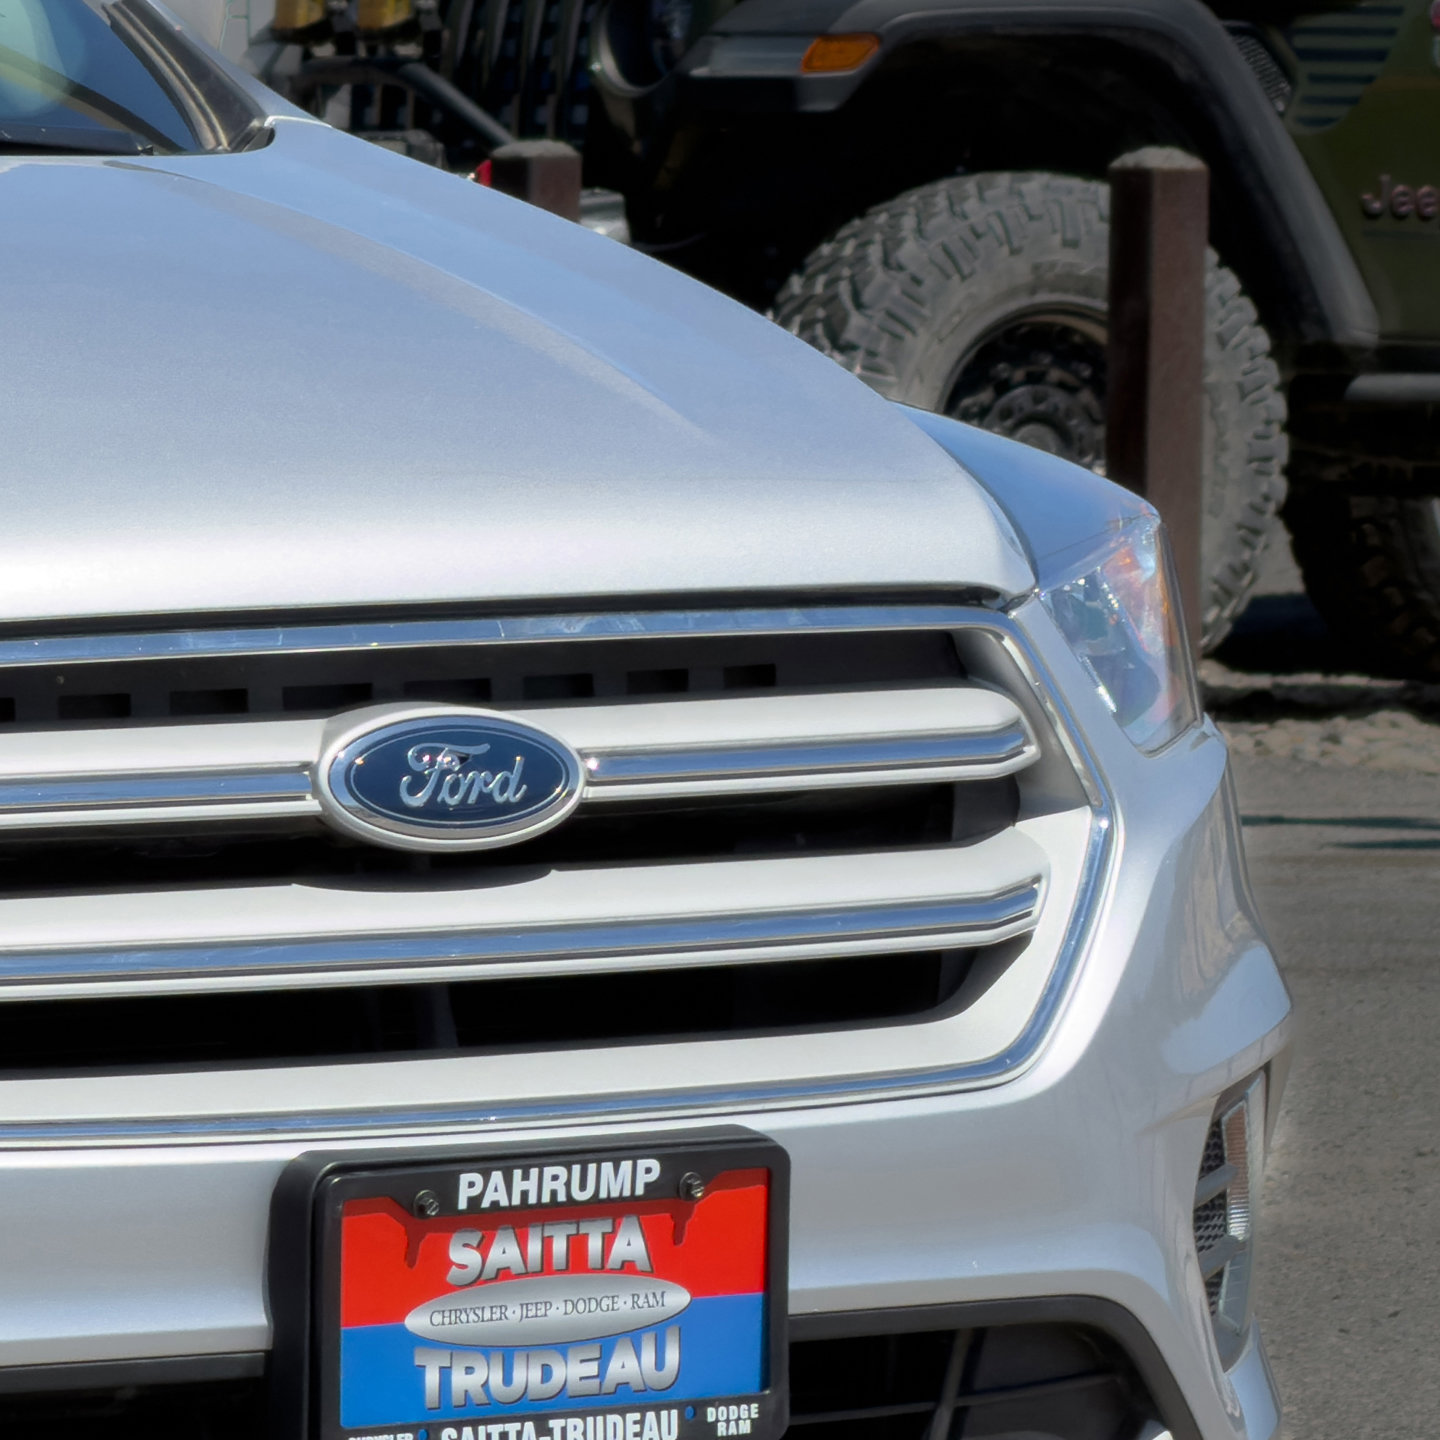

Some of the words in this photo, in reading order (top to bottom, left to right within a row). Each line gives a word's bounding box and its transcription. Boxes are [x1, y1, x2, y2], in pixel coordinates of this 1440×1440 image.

[1358, 172, 1440, 223] Jee
[398, 742, 529, 809] Ford
[457, 1159, 661, 1210] PAHRUMP
[446, 1214, 655, 1287] SAITTA
[429, 1304, 509, 1328] CHRYSLER
[518, 1300, 553, 1324] JEEP
[562, 1294, 621, 1316] DODGE
[630, 1291, 666, 1310] RAM
[414, 1325, 681, 1412] TRUDEAU
[706, 1403, 760, 1423] DODGE
[717, 1419, 753, 1438] RAM
